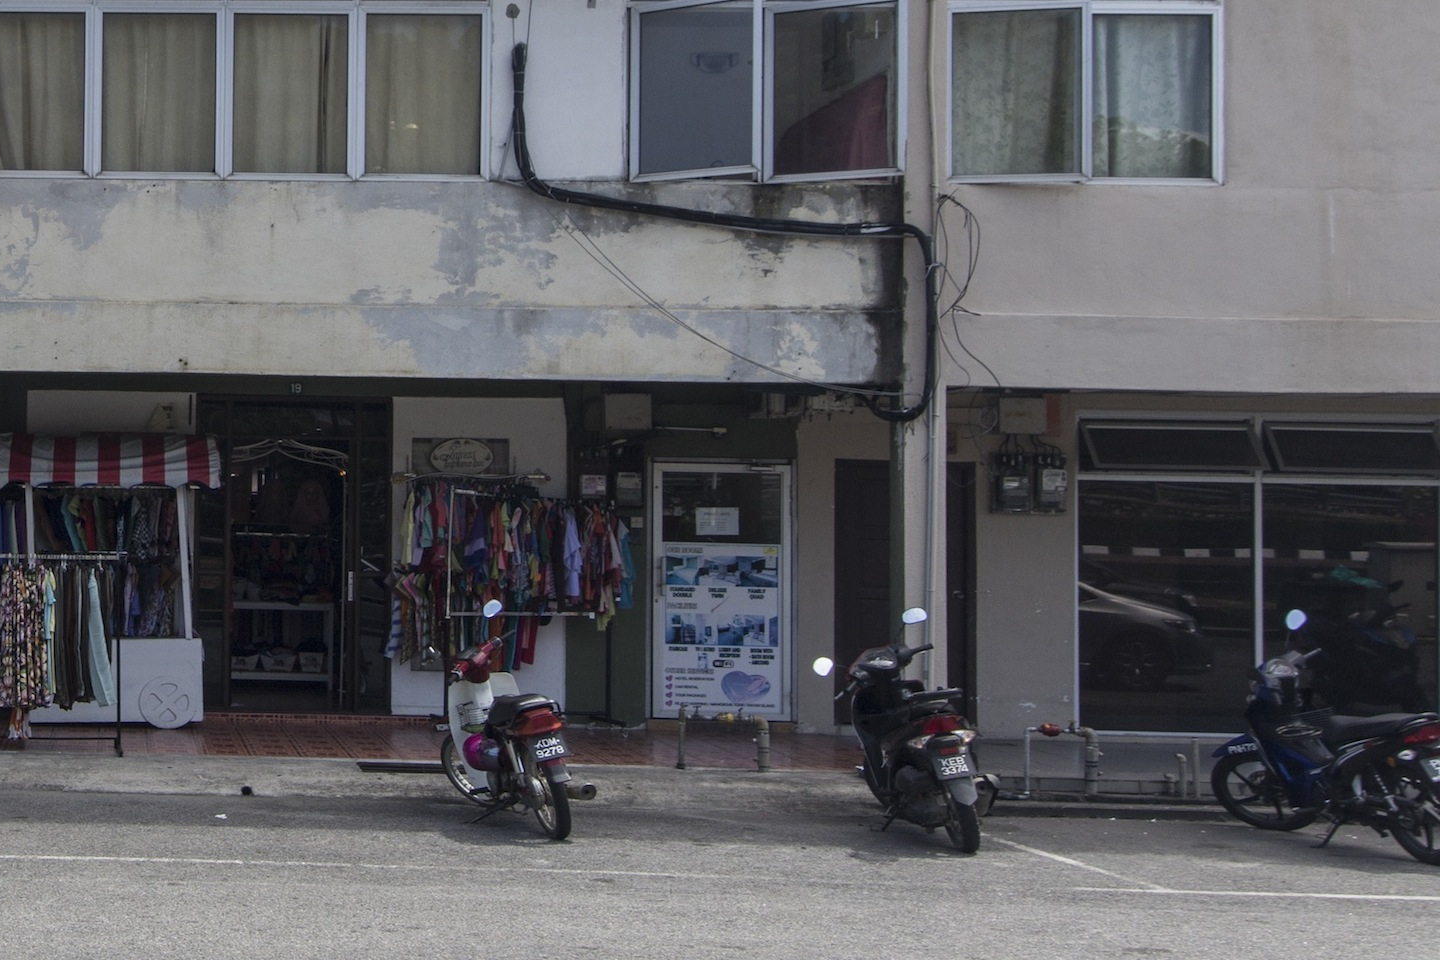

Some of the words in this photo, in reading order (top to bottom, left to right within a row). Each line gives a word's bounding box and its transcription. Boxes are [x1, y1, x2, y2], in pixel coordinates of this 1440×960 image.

[290, 383, 302, 394] 19
[536, 745, 564, 758] 9278
[940, 756, 965, 766] KEB
[941, 764, 968, 775] 3374
